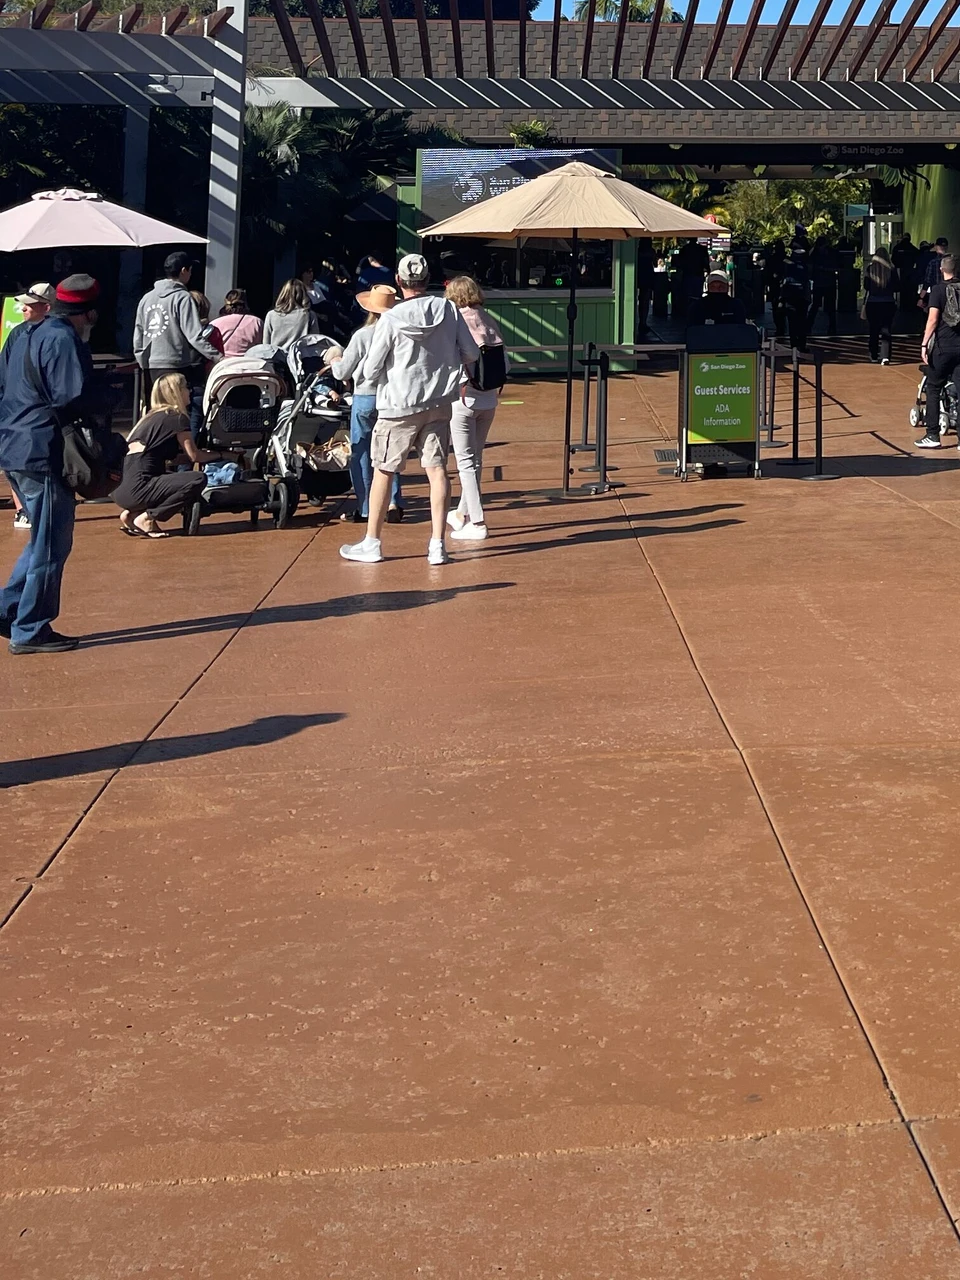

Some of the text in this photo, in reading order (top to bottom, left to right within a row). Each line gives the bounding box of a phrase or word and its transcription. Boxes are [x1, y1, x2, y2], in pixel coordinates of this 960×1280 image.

[841, 145, 904, 156] San Diego Zoo
[694, 384, 751, 396] Guest Services
[715, 404, 730, 413] ADA
[703, 417, 741, 426] Information
